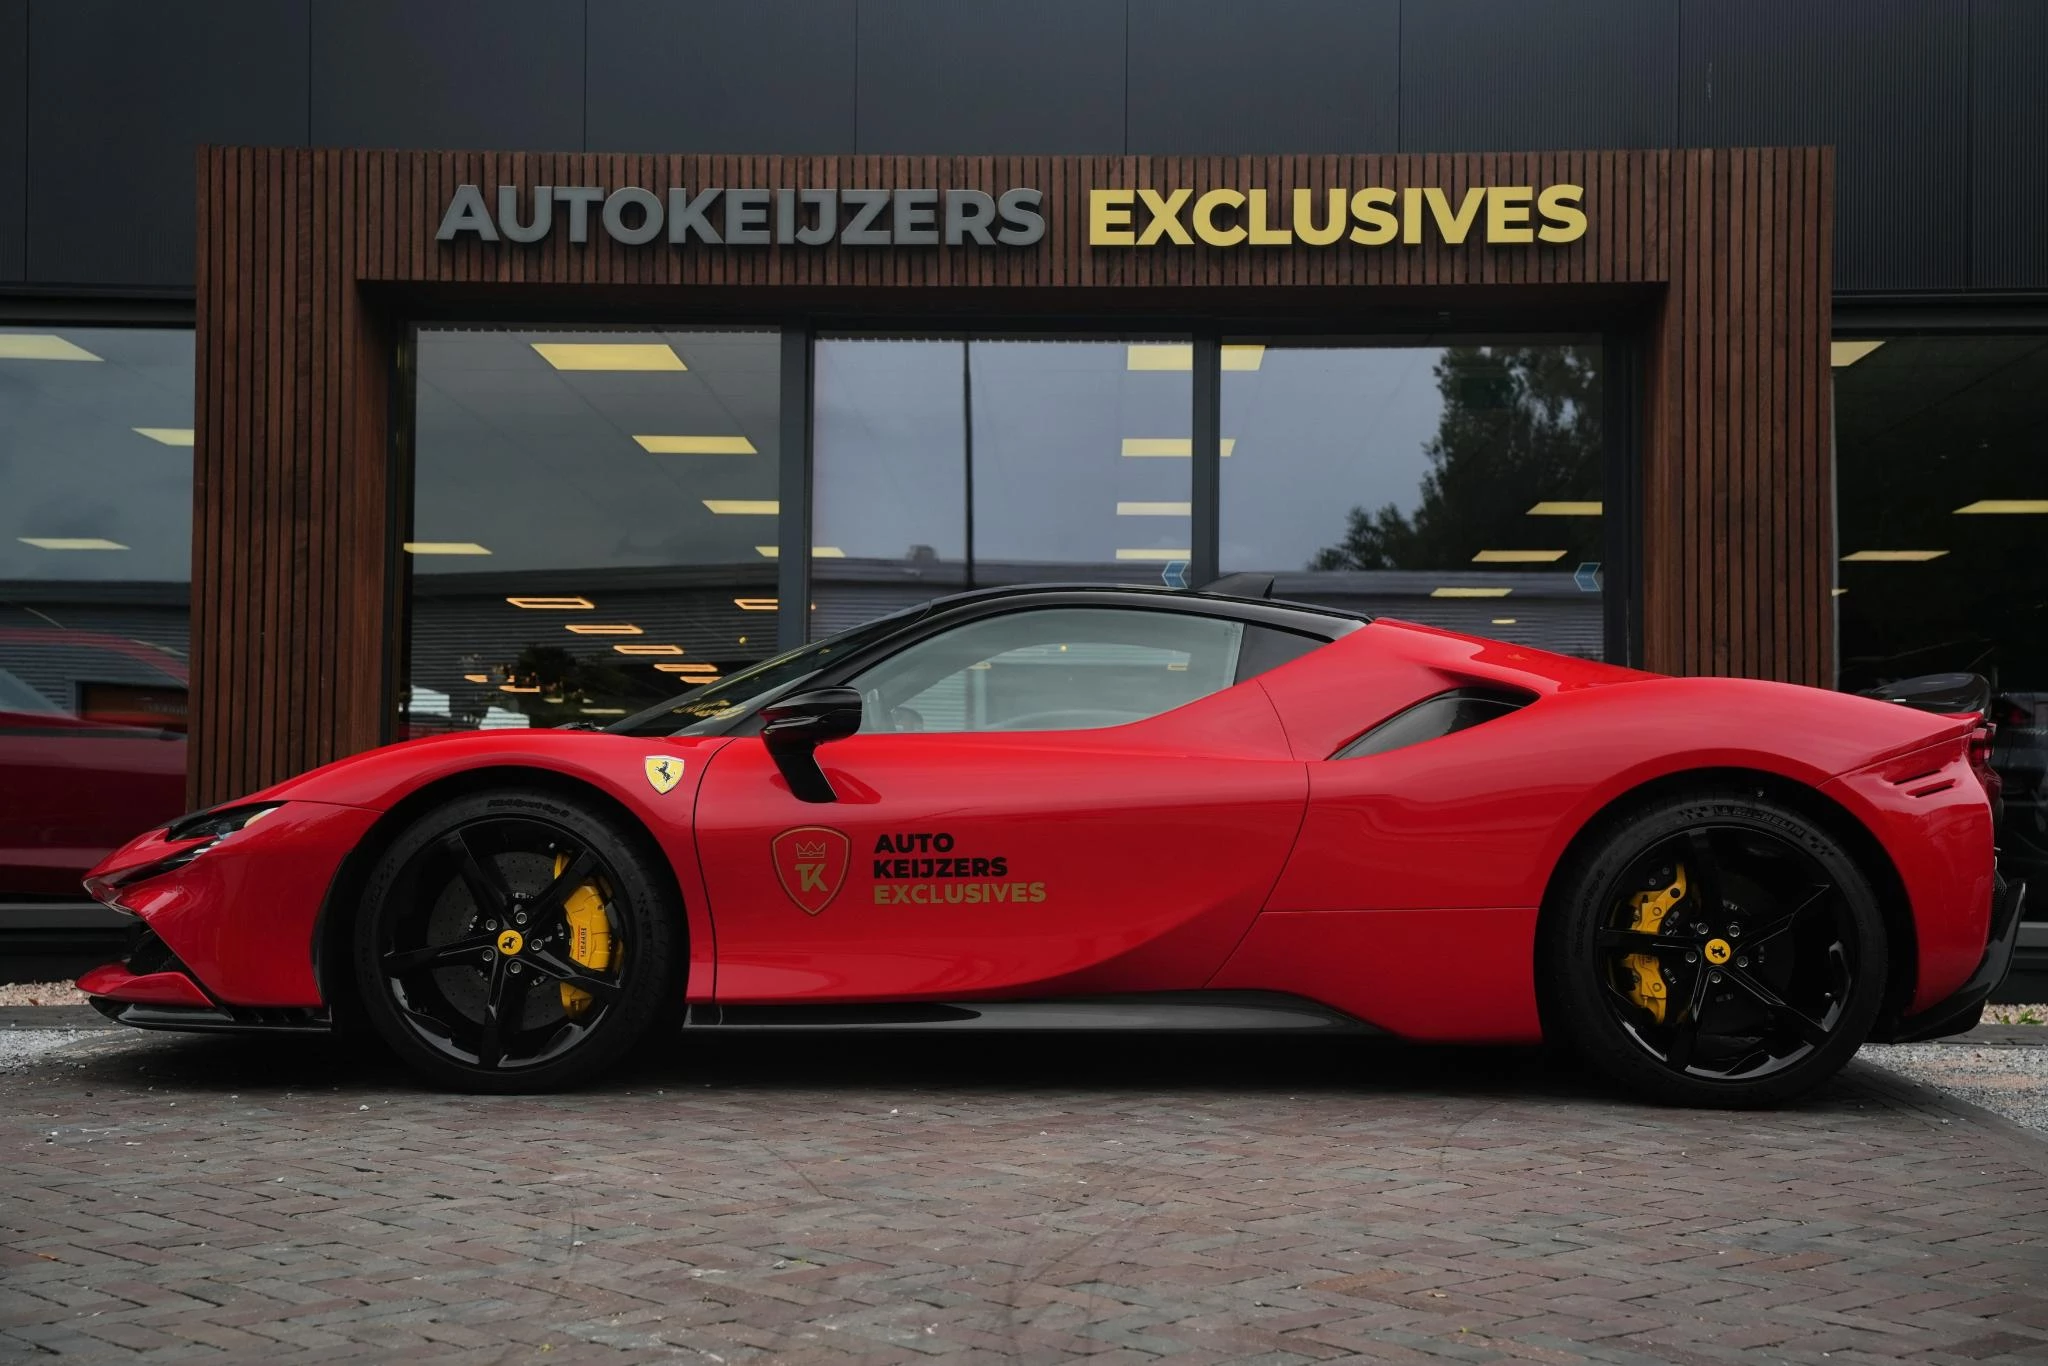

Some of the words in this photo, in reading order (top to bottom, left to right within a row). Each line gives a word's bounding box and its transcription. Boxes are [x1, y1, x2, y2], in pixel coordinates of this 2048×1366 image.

[435, 184, 1046, 246] AUTOKEIJZERS
[1089, 184, 1588, 247] EXCLUSIVES
[874, 833, 955, 854] AUTO
[874, 857, 1007, 879] KEIJZERS
[874, 882, 1046, 904] EXCLUSIVES
